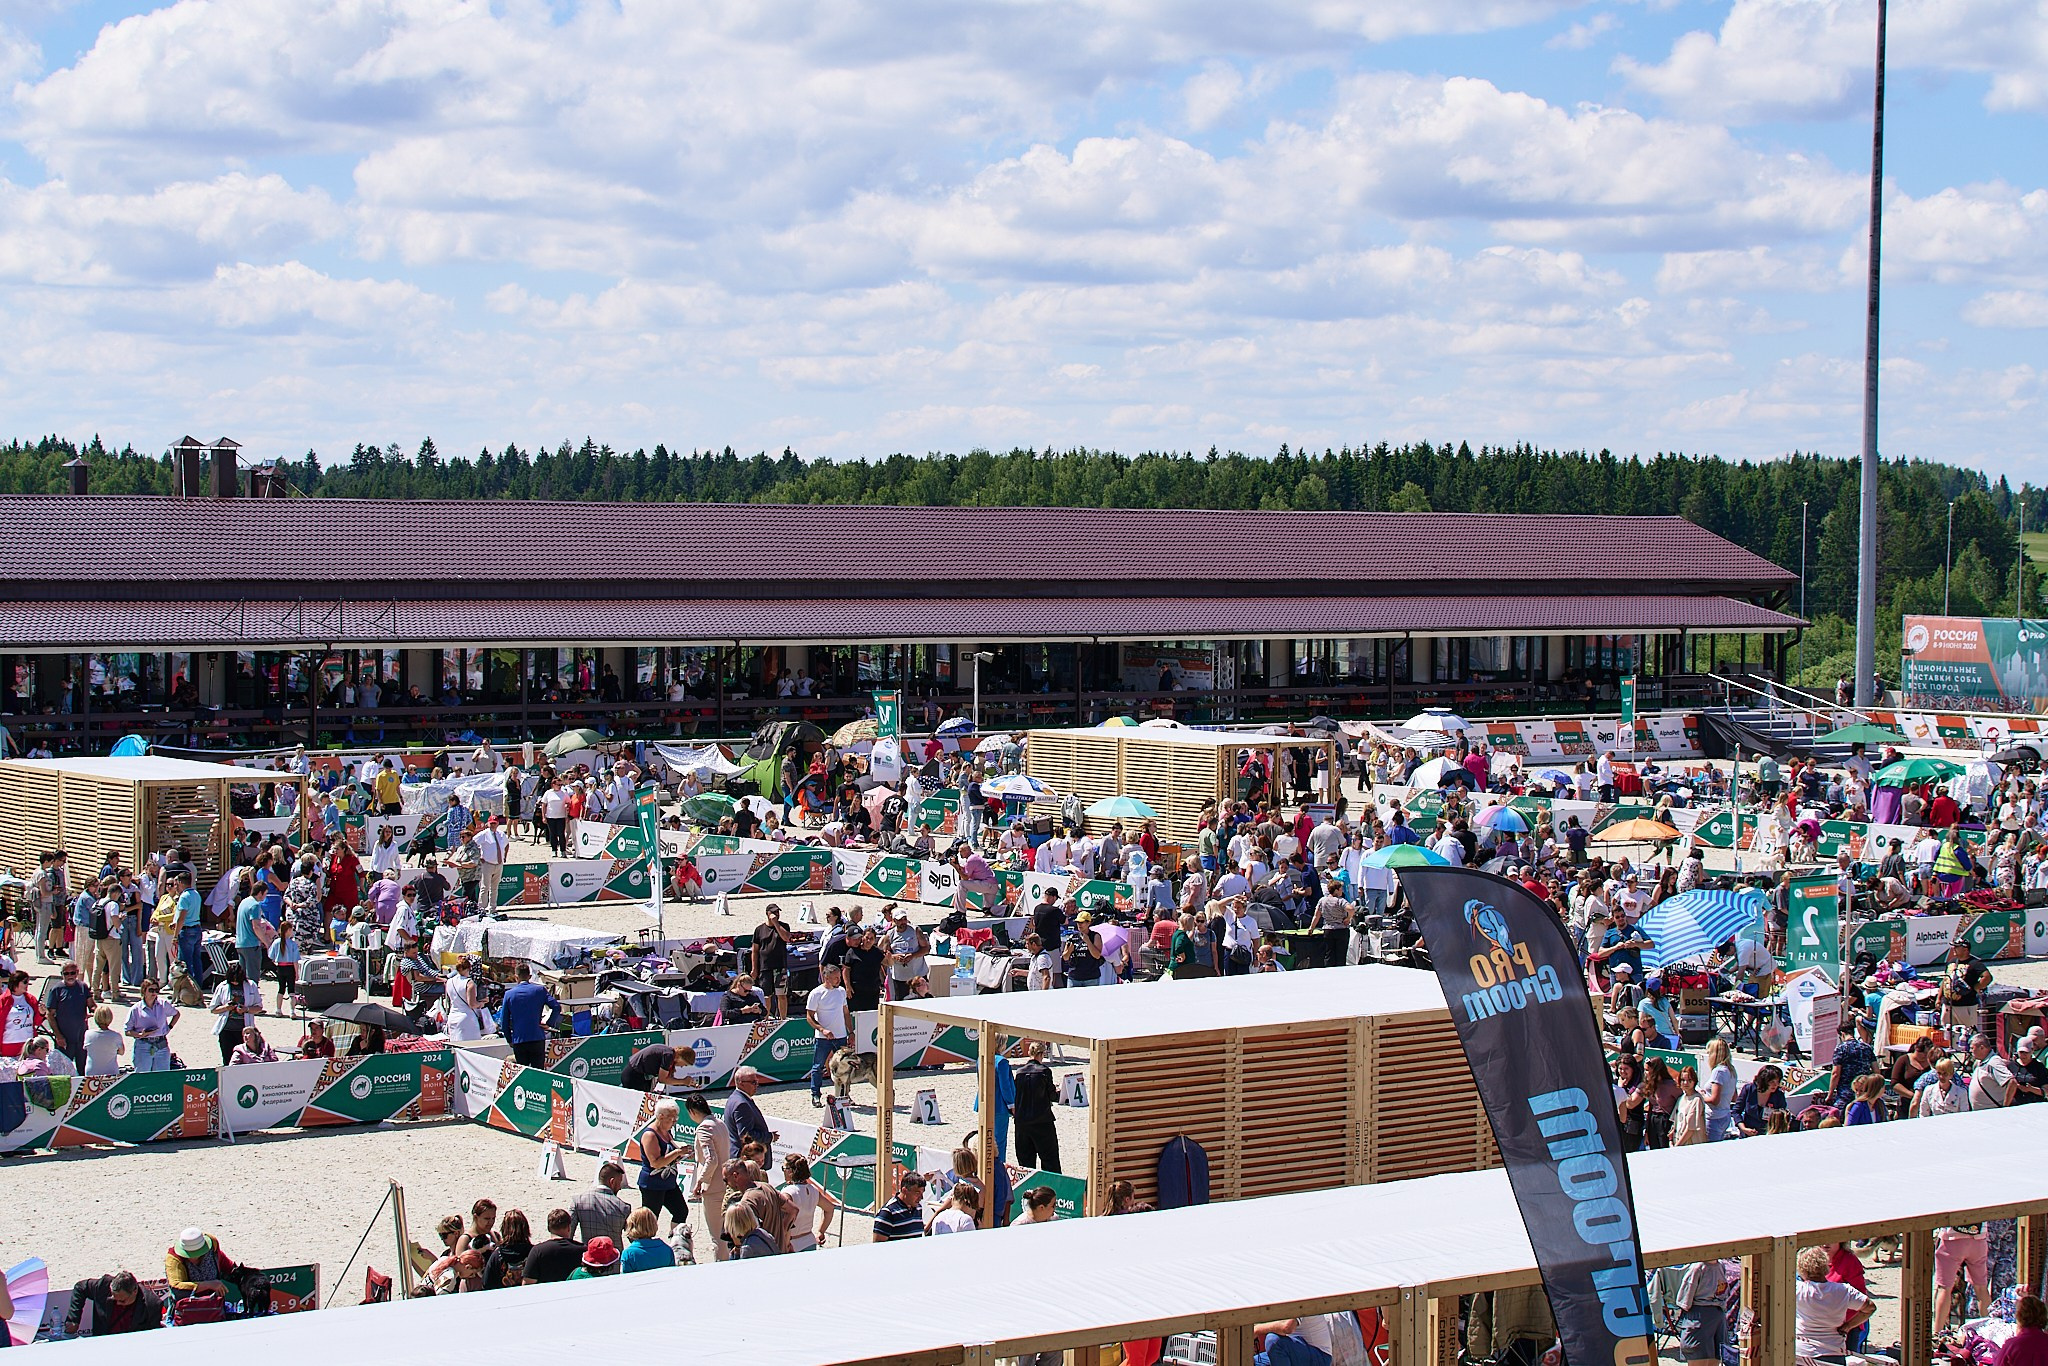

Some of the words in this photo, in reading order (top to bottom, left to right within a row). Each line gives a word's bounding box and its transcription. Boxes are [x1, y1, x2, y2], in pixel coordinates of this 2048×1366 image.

[1933, 630, 1978, 642] РОССИЯ
[1908, 664, 1976, 674] НАЦИОНАЛЬНЫЕ
[1908, 674, 1951, 682] ВЫСТАВКИ
[1954, 675, 1982, 683] СОБАК
[1930, 683, 1960, 692] ПОРОД
[888, 798, 900, 814] 13
[1765, 843, 1771, 854] 2
[800, 908, 806, 920] 2
[1916, 930, 1948, 944] AlphaPet
[790, 1037, 816, 1046] РОССИ
[423, 1054, 442, 1062] 2024
[696, 1048, 714, 1057] rmina
[591, 1056, 624, 1066] РОССИЯ
[1666, 1056, 1682, 1065] 2024
[186, 1074, 206, 1082] 2024
[374, 1073, 411, 1084] РОССИЯ
[552, 1079, 564, 1088] 2024
[134, 1093, 172, 1104] РОССИЯ
[526, 1090, 546, 1103] РОССИЯ
[1074, 1083, 1084, 1104] 4
[924, 1100, 935, 1121] 2
[676, 1124, 696, 1134] РОСС
[892, 1146, 908, 1156] 2024
[544, 1153, 550, 1174] 1
[679, 1175, 686, 1192] 3
[1056, 1198, 1074, 1210] СИЯ
[269, 1272, 296, 1284] 2024
